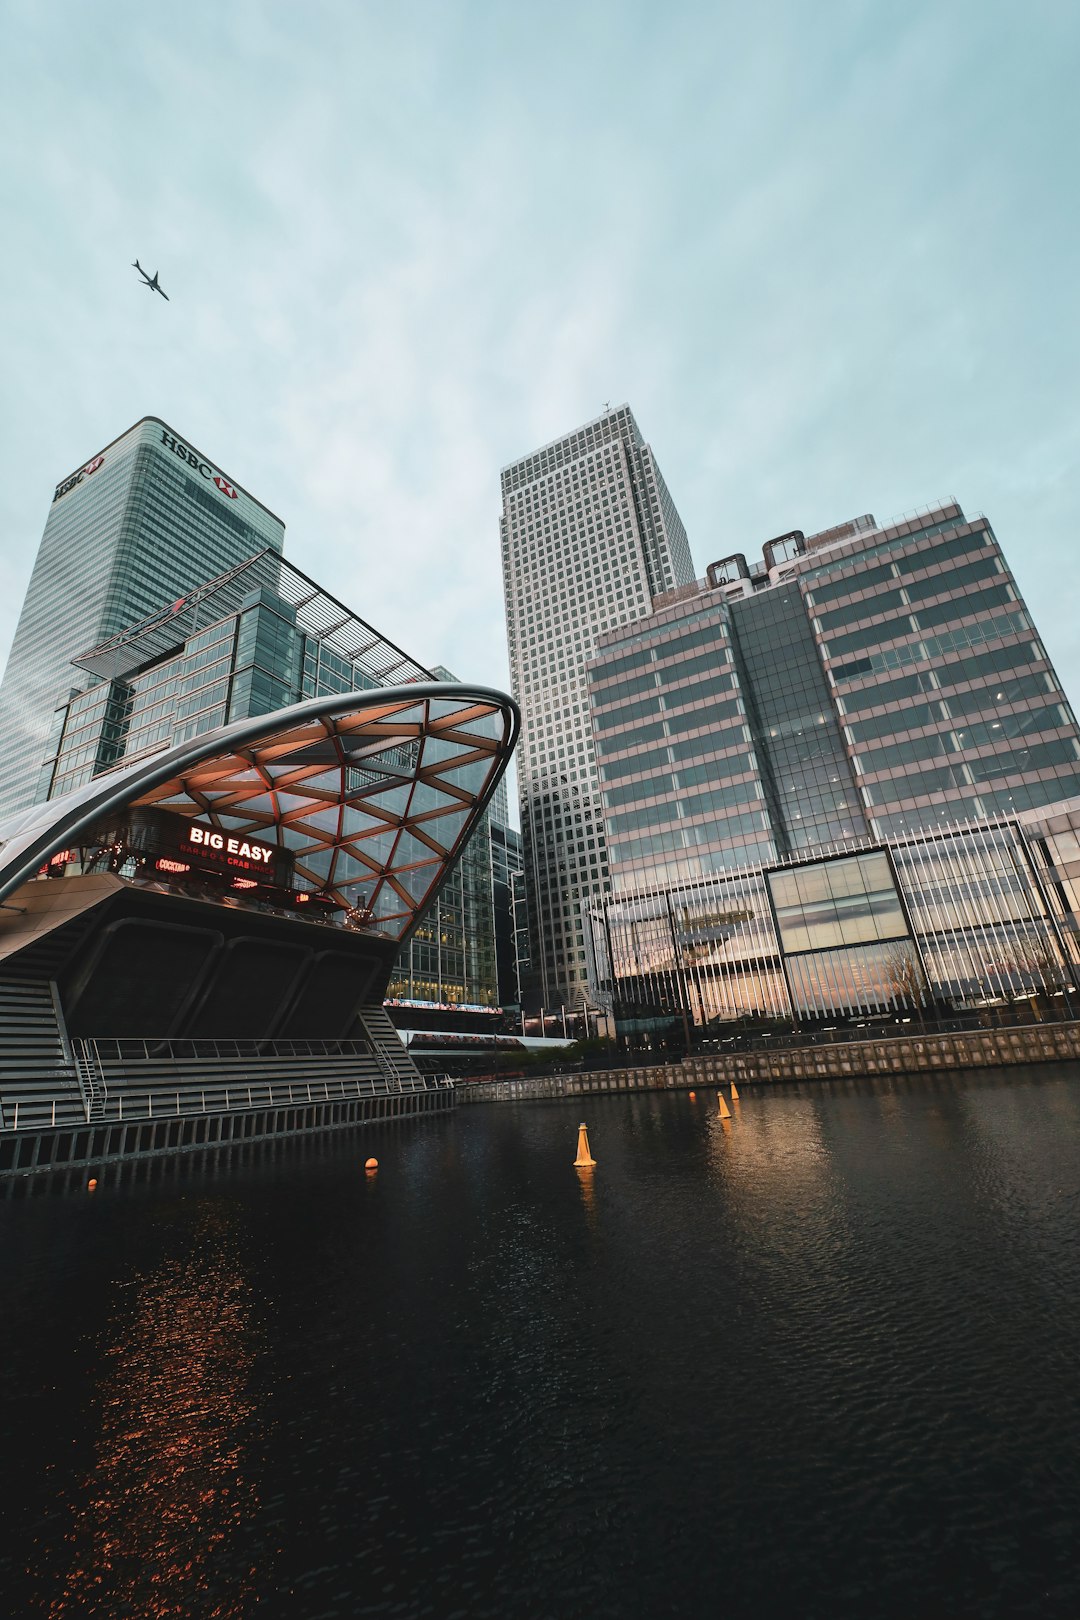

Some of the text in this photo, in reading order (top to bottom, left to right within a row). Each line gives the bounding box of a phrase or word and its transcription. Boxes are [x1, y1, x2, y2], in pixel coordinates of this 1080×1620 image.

[160, 430, 212, 480] HSBC
[190, 827, 272, 863] BIG EASY
